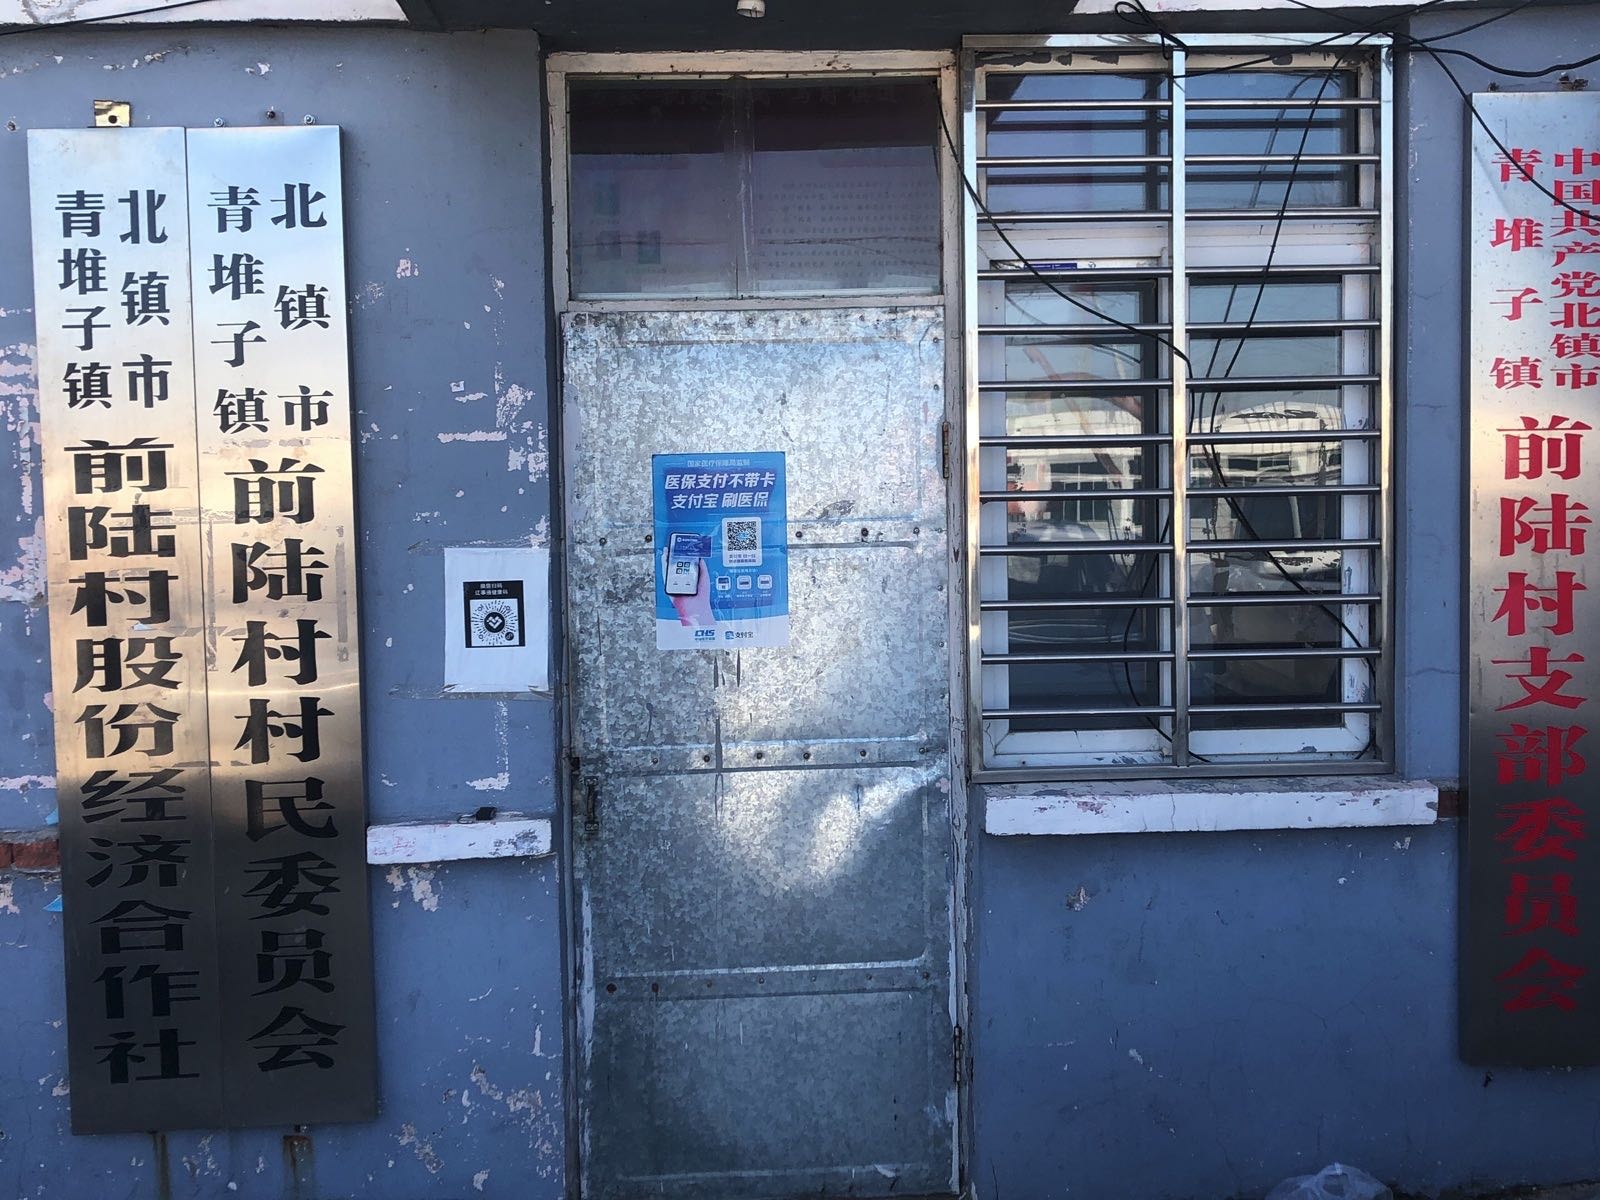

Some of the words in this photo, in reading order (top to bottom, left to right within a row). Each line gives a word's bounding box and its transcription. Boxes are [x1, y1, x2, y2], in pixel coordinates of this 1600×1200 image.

[54, 190, 113, 410] 青堆子镇
[117, 189, 173, 409] 北镇市
[207, 186, 271, 434] 青堆子镇
[270, 184, 335, 433] 北镇市
[1489, 148, 1544, 390] 青堆子镇
[1549, 147, 1600, 390] 中国共产党北镇市
[664, 472, 776, 490] 医保支付不带卡
[671, 493, 719, 509] 支付宝
[64, 437, 201, 1085] 前陆村股份经济合作社
[223, 458, 347, 1072] 前陆村村民委员会
[1490, 415, 1593, 1014] 前陆村支部委员会
